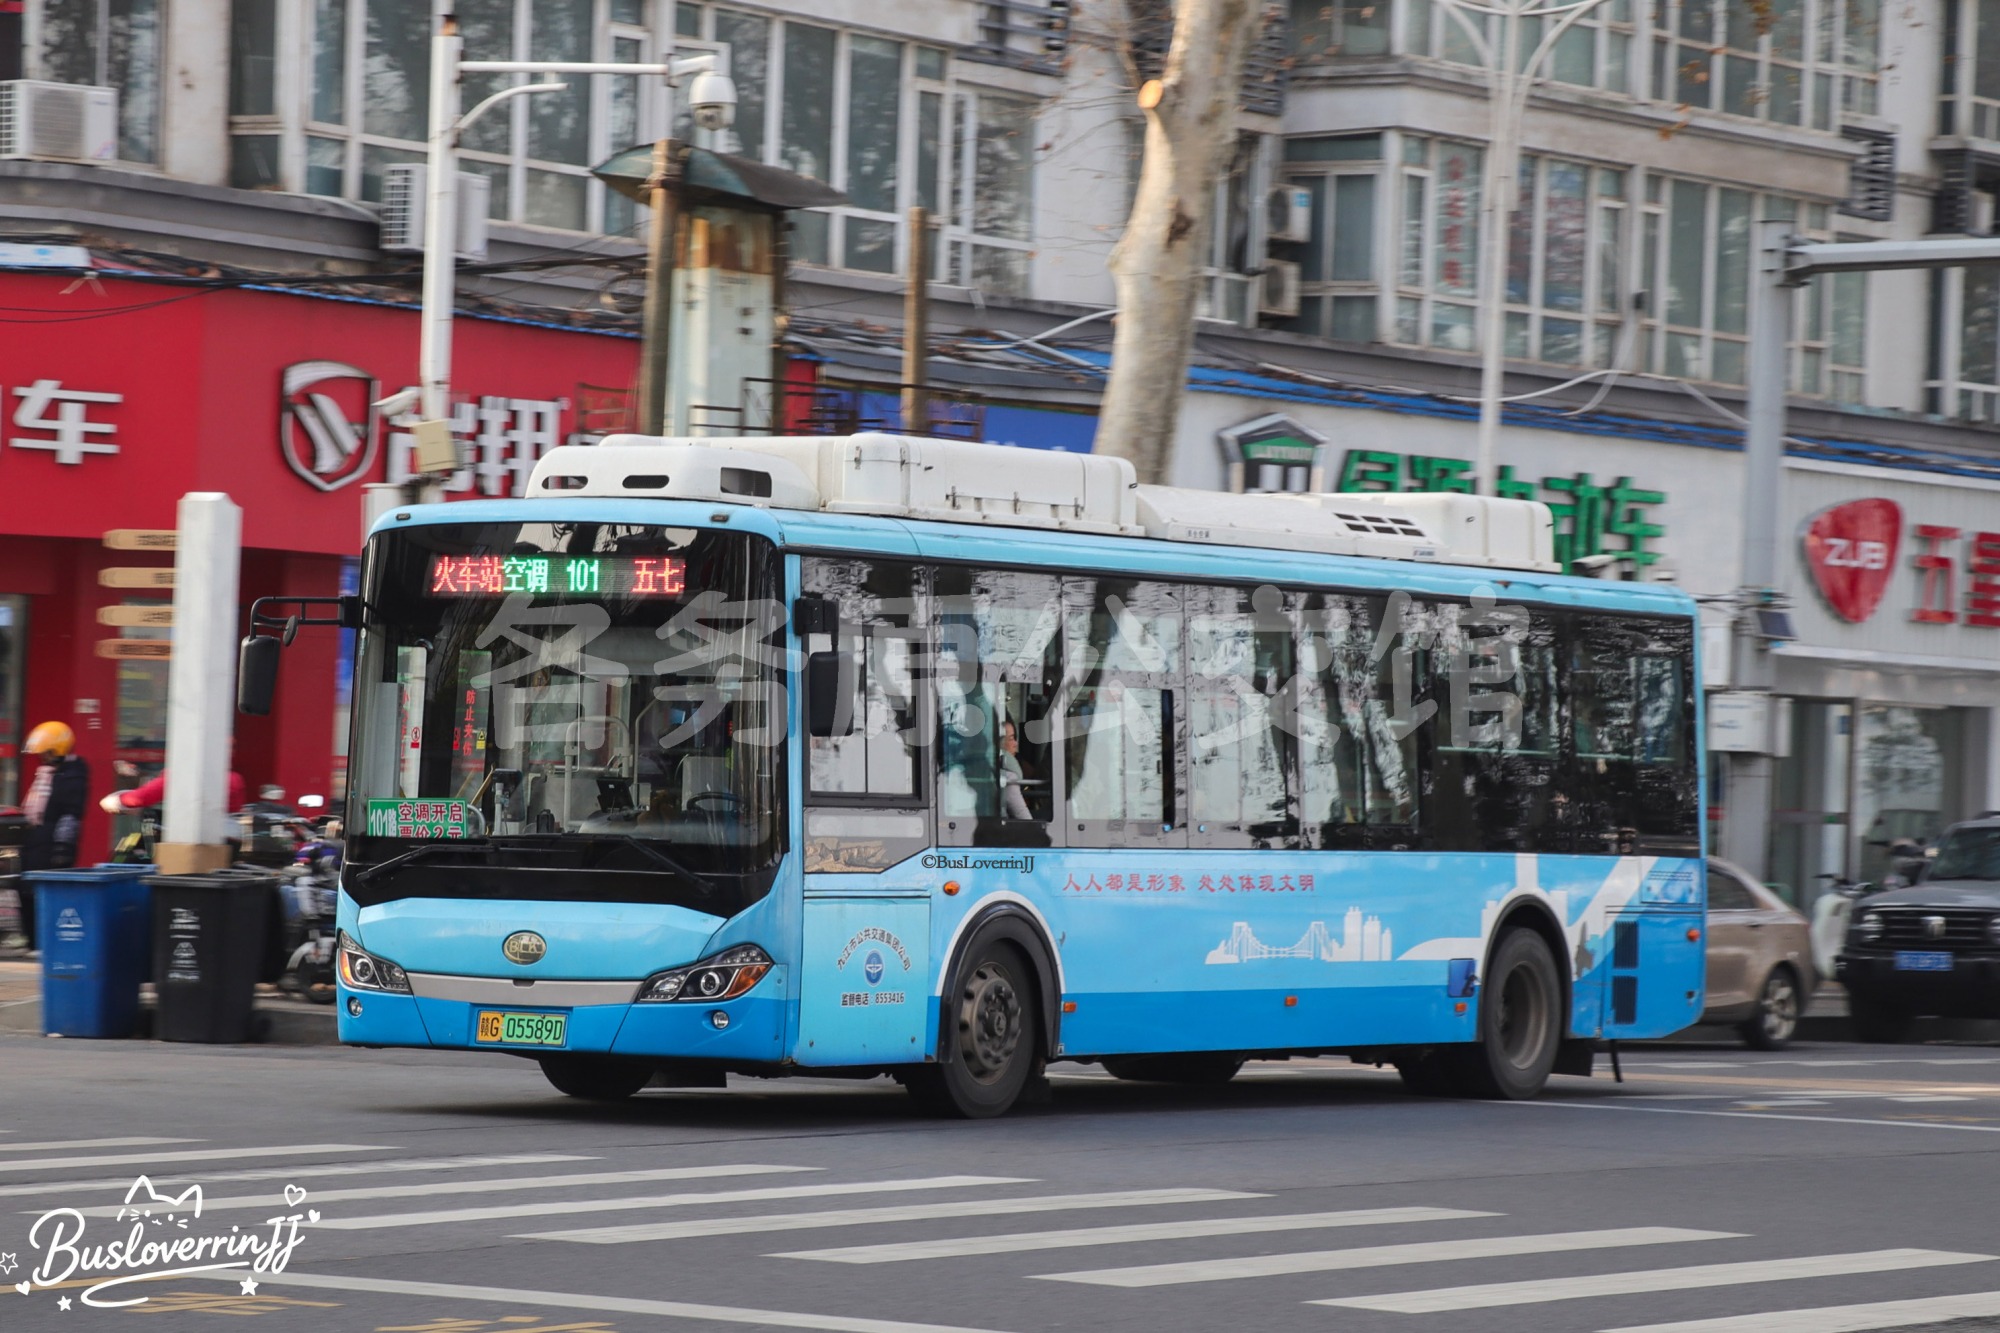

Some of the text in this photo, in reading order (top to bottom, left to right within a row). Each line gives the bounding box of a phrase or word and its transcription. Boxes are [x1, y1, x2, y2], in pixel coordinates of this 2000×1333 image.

[0, 379, 124, 465] 车
[566, 558, 601, 592] 101
[398, 802, 464, 823] 空调开启
[1062, 873, 1316, 893] 人人都是形象 处处体现文明
